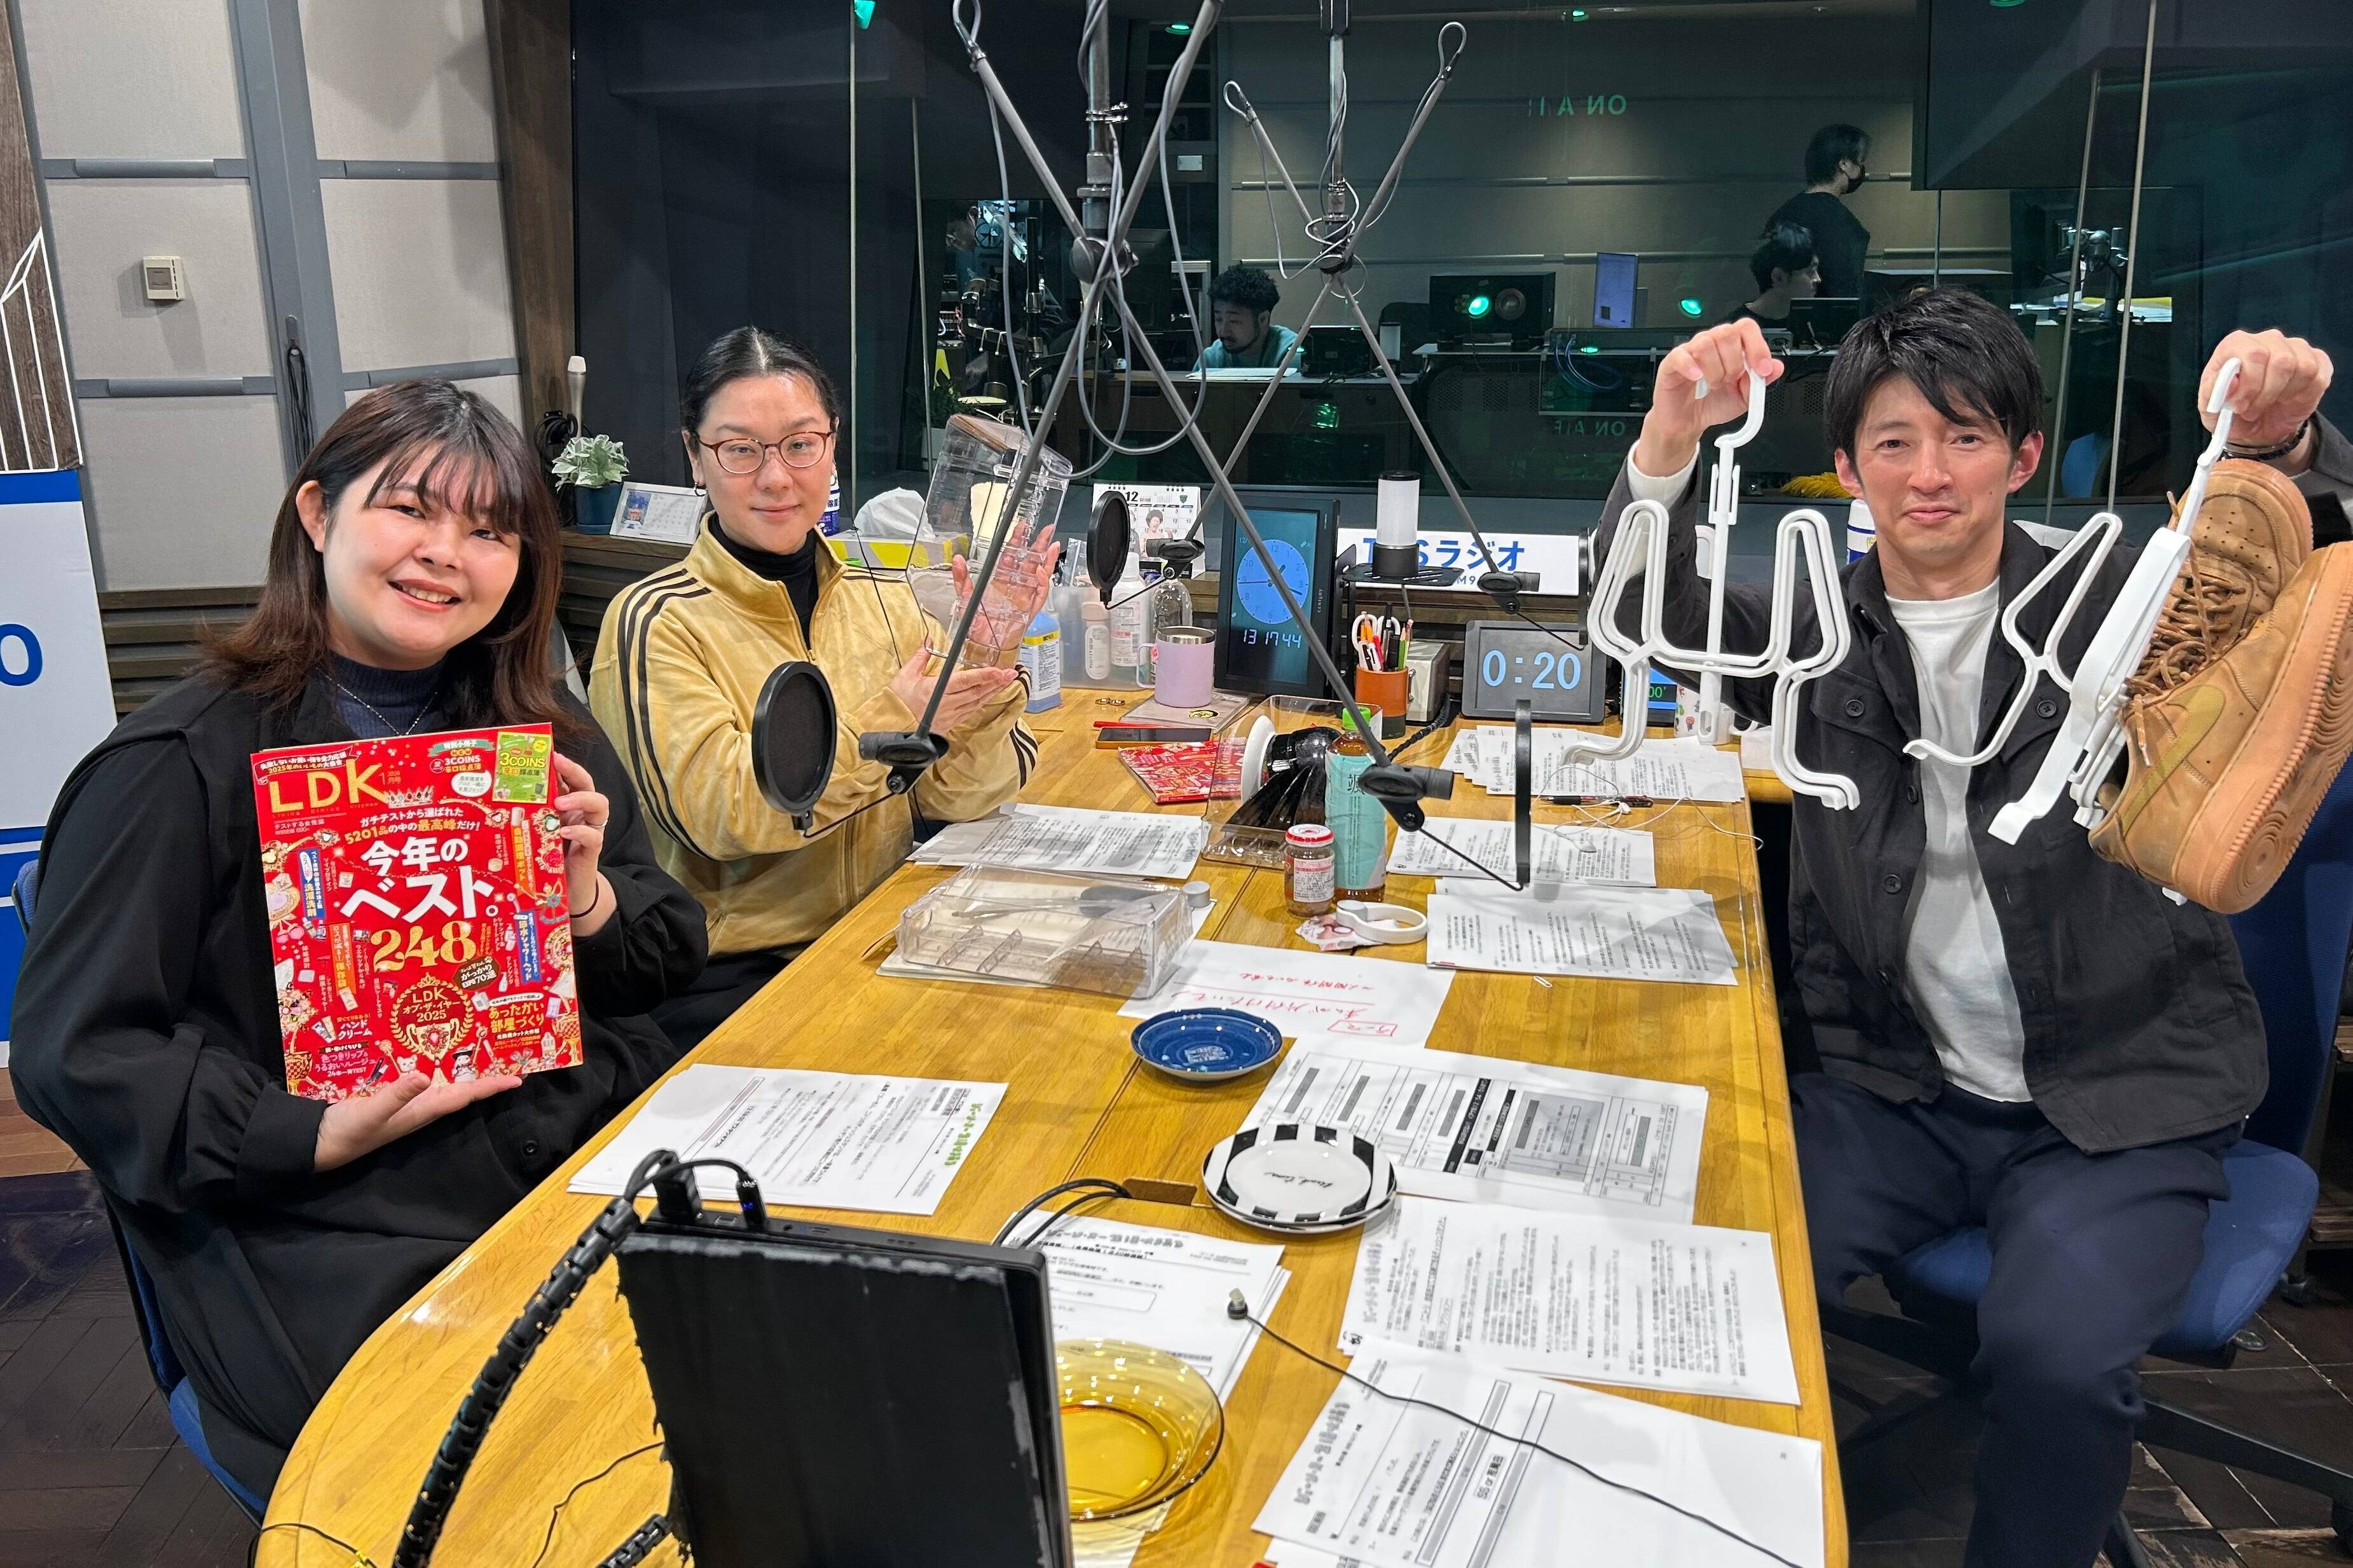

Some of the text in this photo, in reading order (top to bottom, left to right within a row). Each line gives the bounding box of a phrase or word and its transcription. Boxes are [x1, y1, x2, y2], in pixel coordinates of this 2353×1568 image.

[1363, 538, 1525, 571] TSラジオ
[1483, 650, 1581, 690] 0:20
[444, 754, 481, 765] 3COINS
[500, 752, 545, 768] 3COINS
[270, 759, 388, 814] LDK
[360, 807, 464, 828] ガチテストから選ばれた
[360, 836, 469, 876] 今年の
[370, 920, 477, 972] 248
[413, 986, 449, 1004] LDK
[417, 1009, 447, 1023] 2025
[488, 1002, 544, 1019] あったかい
[341, 1019, 367, 1029] ハンド
[490, 1013, 544, 1033] 部屋づくり
[338, 1028, 373, 1040] クリーム
